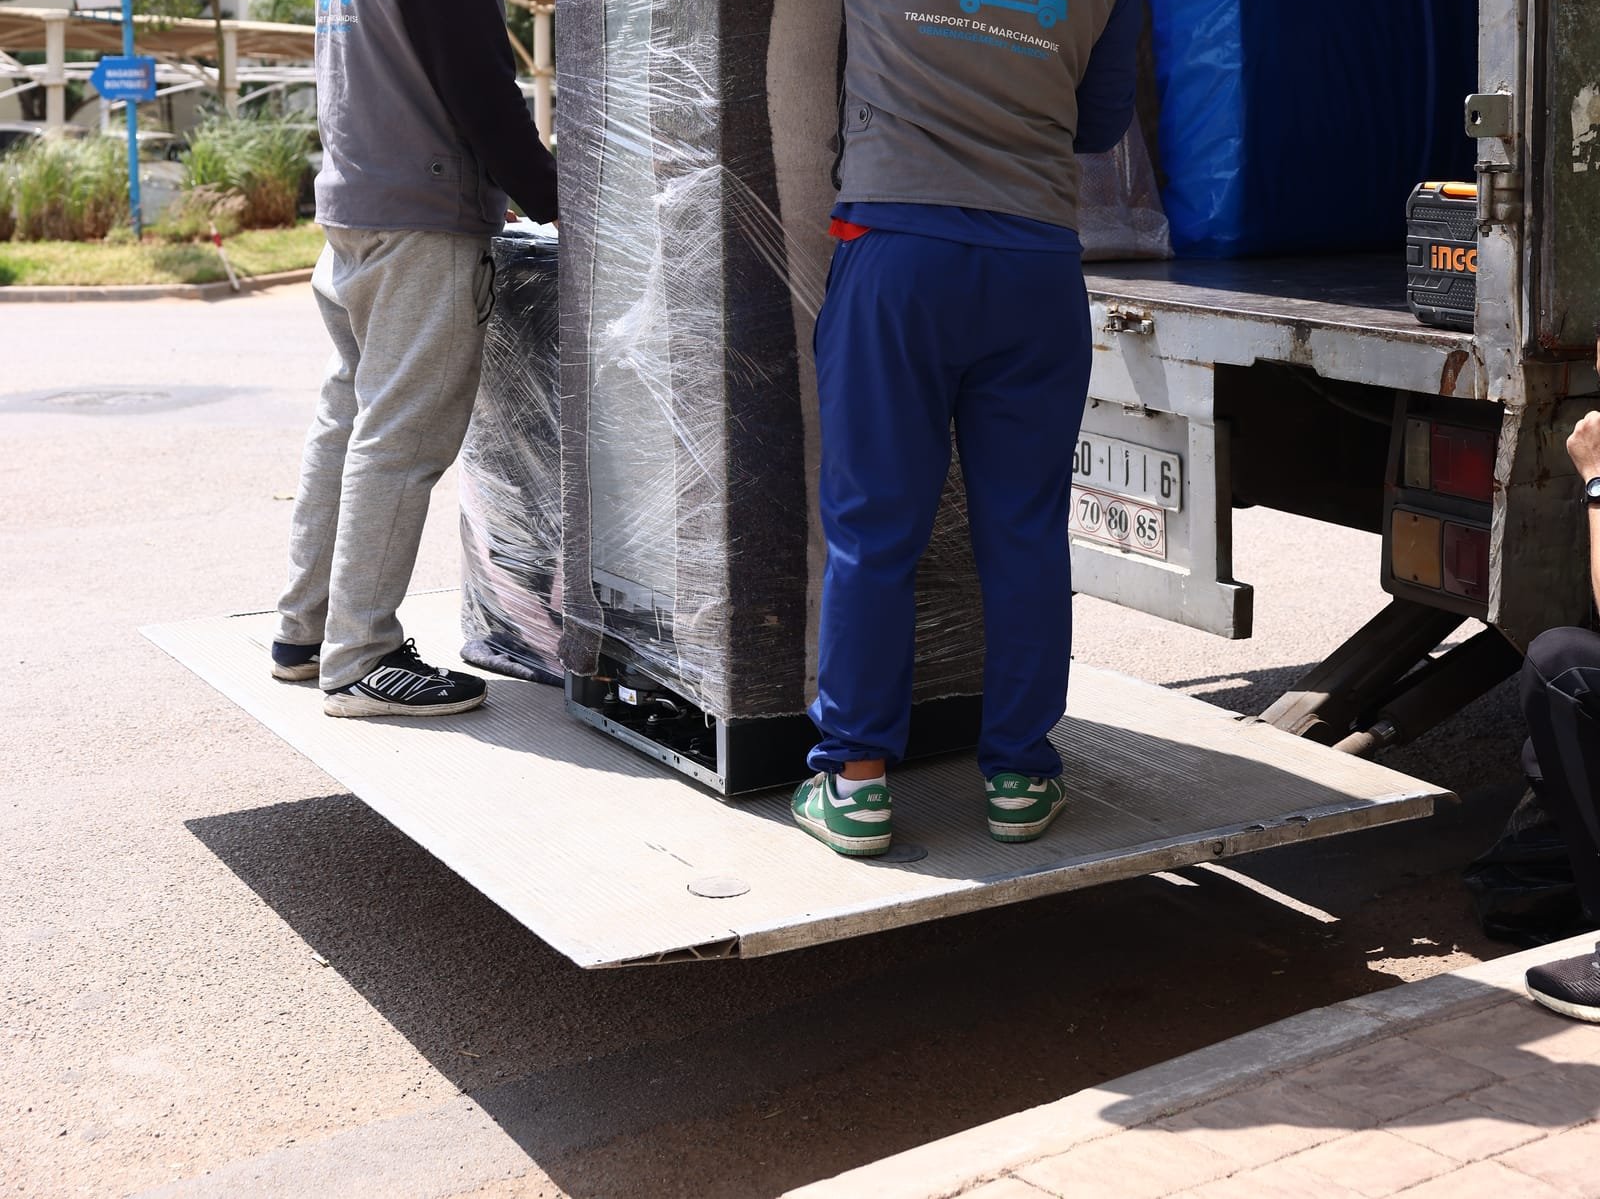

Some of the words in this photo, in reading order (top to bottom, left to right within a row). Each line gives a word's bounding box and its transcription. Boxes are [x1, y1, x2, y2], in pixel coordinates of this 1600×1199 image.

[904, 11, 970, 28] TRANSPORT
[971, 20, 986, 32] DE
[1160, 460, 1172, 499] 6
[1080, 499, 1100, 525] 70
[1108, 506, 1129, 533] 80
[1136, 514, 1157, 541] 85
[1002, 780, 1019, 790] NIKE
[866, 792, 883, 803] NIKE
